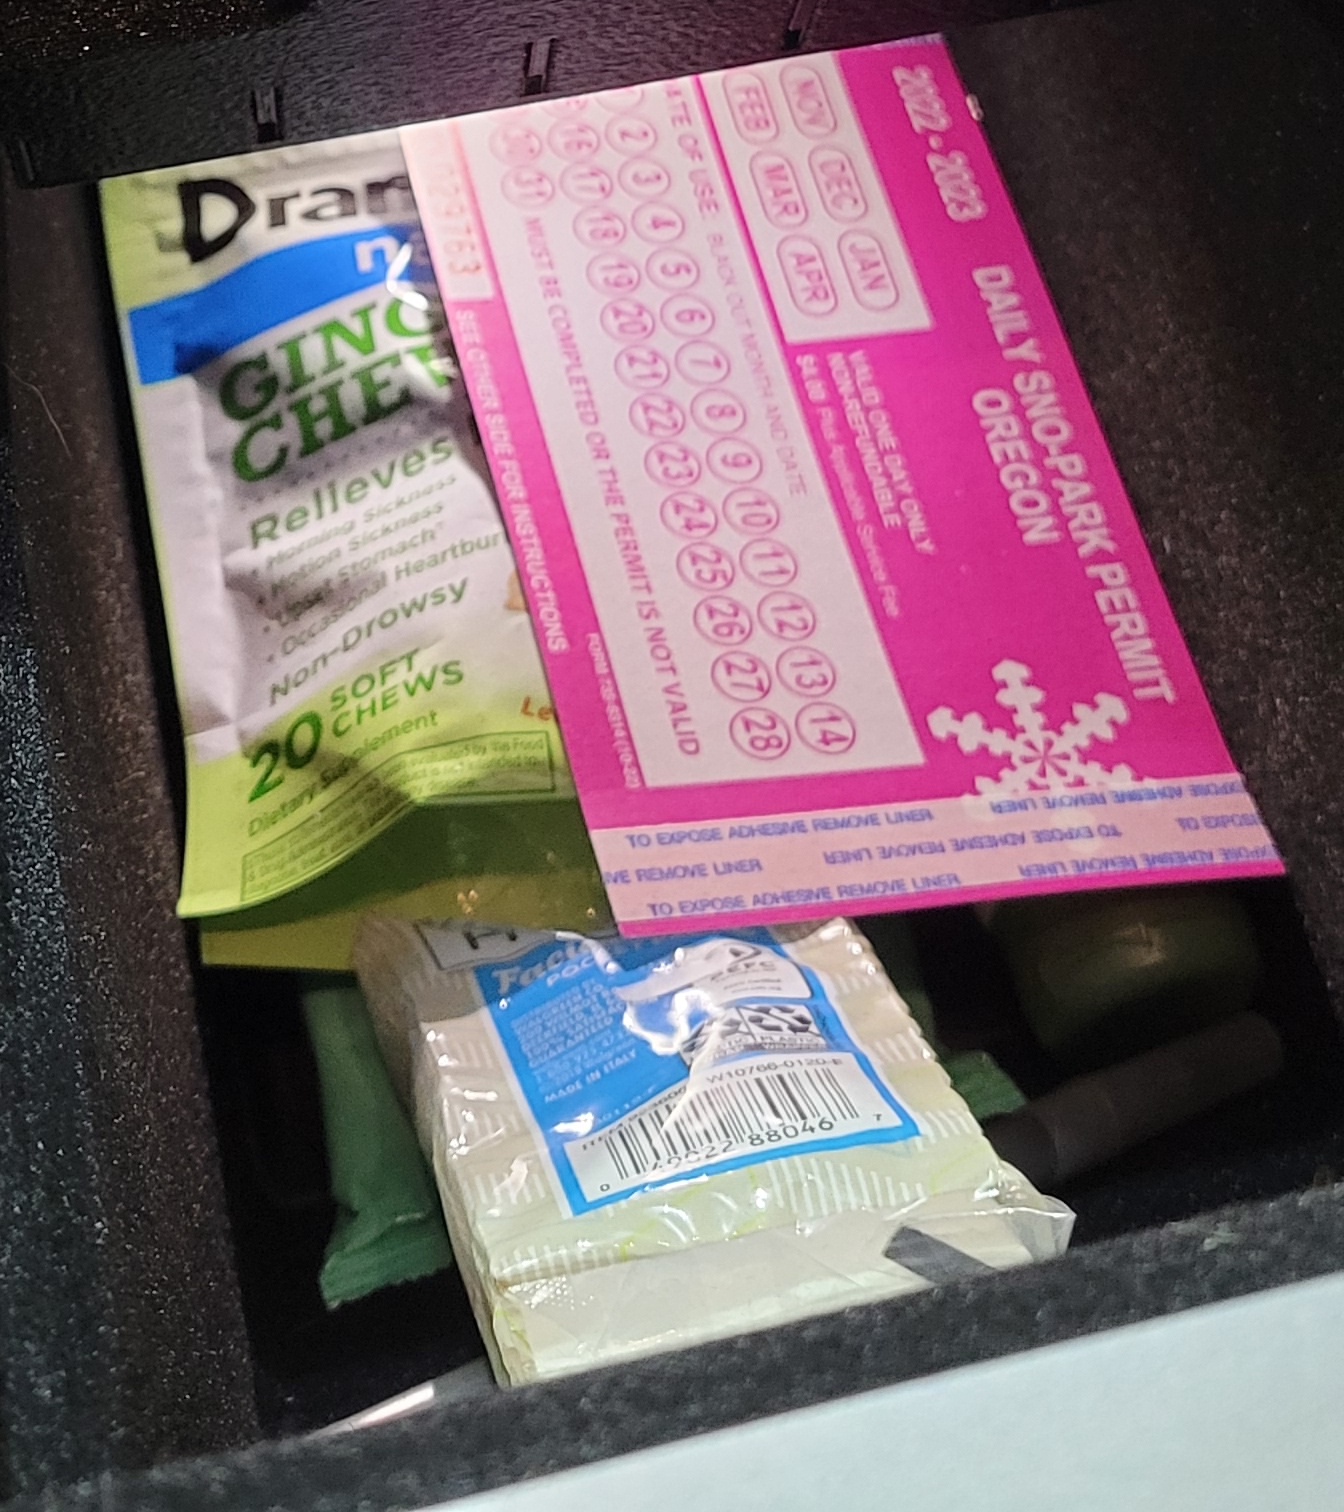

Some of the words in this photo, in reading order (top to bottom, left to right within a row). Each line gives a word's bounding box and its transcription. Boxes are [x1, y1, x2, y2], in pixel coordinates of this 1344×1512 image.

[619, 126, 649, 141] 2
[572, 170, 607, 197] 17
[632, 169, 661, 185] 3
[733, 85, 769, 132] FEB
[759, 163, 799, 217] MAR
[789, 251, 830, 304] APR
[789, 78, 828, 128] NOV
[818, 158, 859, 211] DEC
[848, 241, 888, 291] JAN
[926, 149, 988, 222] 2023
[649, 214, 675, 229] 4
[522, 217, 552, 271] MUST
[600, 262, 634, 289] 19
[659, 260, 691, 277] 5
[538, 274, 562, 299] BE
[456, 308, 481, 346] SEE
[611, 303, 648, 336] 20
[674, 307, 706, 324] 6
[676, 133, 702, 162] OF
[740, 334, 773, 398] MONTH
[763, 406, 788, 441] AND
[776, 446, 806, 495] DATE
[467, 350, 499, 409] OTHER
[548, 304, 600, 426] COMPLETED
[627, 351, 662, 381] 21
[689, 355, 721, 372] 7
[641, 400, 678, 432] 22
[703, 401, 737, 421] 8
[485, 412, 513, 455] SIDE
[585, 430, 610, 460] OR
[825, 352, 902, 528] NON-REFUNDABLE
[655, 448, 693, 481] 23
[719, 451, 753, 470] 9
[968, 387, 1063, 546] OREGON
[249, 435, 455, 549] Relieves
[497, 458, 525, 500] FOR
[597, 466, 623, 506] THE
[867, 409, 895, 449] ONE
[883, 454, 912, 496] DAY
[898, 498, 933, 555] ONLY
[971, 265, 1044, 366] DAILY
[1009, 369, 1119, 558] SNO-PARK
[1084, 562, 1177, 706] PERMIT
[362, 473, 458, 524] Sickness
[671, 498, 710, 533] 24
[735, 497, 773, 529] 10
[348, 500, 444, 551] Sickness
[394, 530, 508, 583] Heartbur
[610, 511, 651, 596] PERMIT
[687, 548, 728, 585] 25
[751, 549, 789, 579] 11
[511, 503, 568, 652] INSTRUCTIONS
[636, 599, 660, 621] IS
[704, 601, 745, 638] 26
[769, 602, 809, 635] 12
[269, 576, 469, 707] Non-Drowsy
[644, 625, 676, 677] NOT
[329, 647, 420, 712] SOFT
[722, 657, 766, 697] 27
[788, 657, 828, 690] 13
[331, 660, 465, 738] CHEWS
[520, 695, 556, 722] Le
[661, 681, 700, 756] VALID
[741, 714, 784, 752] 28
[808, 714, 848, 747] 14
[247, 710, 323, 803] 20
[247, 782, 319, 838] Dietary
[990, 797, 1037, 815] LINER
[1042, 792, 1106, 811] REMOVE
[625, 833, 651, 849] TO
[656, 827, 723, 846] EXPOSE
[729, 820, 807, 840] ADHESIVE
[812, 813, 881, 833] REMOVE
[885, 808, 933, 824] LINER
[952, 832, 1026, 853] ADHESIVE
[1033, 825, 1095, 844] EXPOSE
[1096, 823, 1123, 839] TO
[823, 846, 873, 865] LINER
[877, 840, 945, 859] REMOVE
[635, 863, 708, 882] REMOVE
[713, 859, 764, 876] LINER
[1017, 862, 1068, 879] LINER
[647, 901, 674, 917] TO
[678, 895, 746, 914] EXPOSE
[753, 888, 833, 907] ADHESIVE
[838, 878, 907, 898] REMOVE
[912, 872, 962, 890] LINER
[546, 955, 595, 987] POC
[544, 1078, 582, 1103] MADE
[584, 1068, 602, 1083] IN
[602, 1047, 636, 1073] ITALY
[706, 1057, 844, 1085] W10766-0120-E
[748, 1117, 835, 1147] 88046
[872, 1113, 884, 1123] 7
